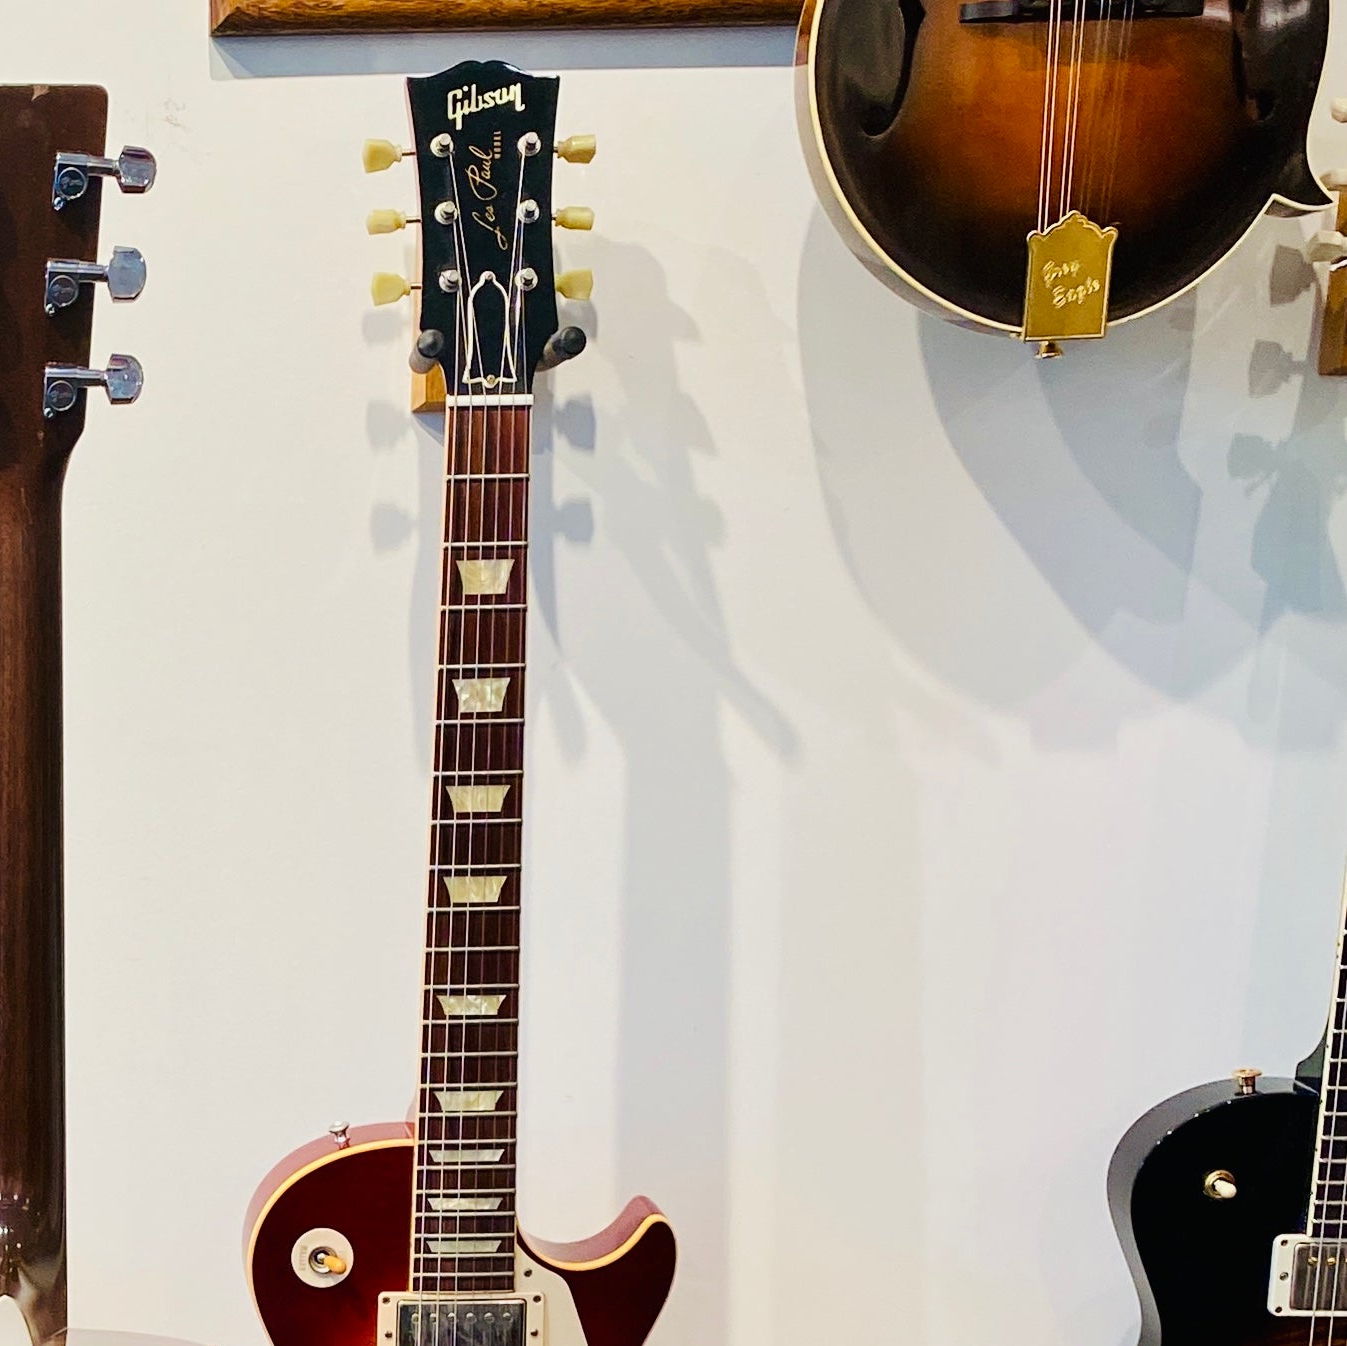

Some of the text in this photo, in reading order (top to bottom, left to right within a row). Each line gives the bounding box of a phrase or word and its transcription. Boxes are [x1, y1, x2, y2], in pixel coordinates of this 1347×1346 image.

[447, 82, 525, 130] Gibson
[464, 144, 508, 250] Les Paul
